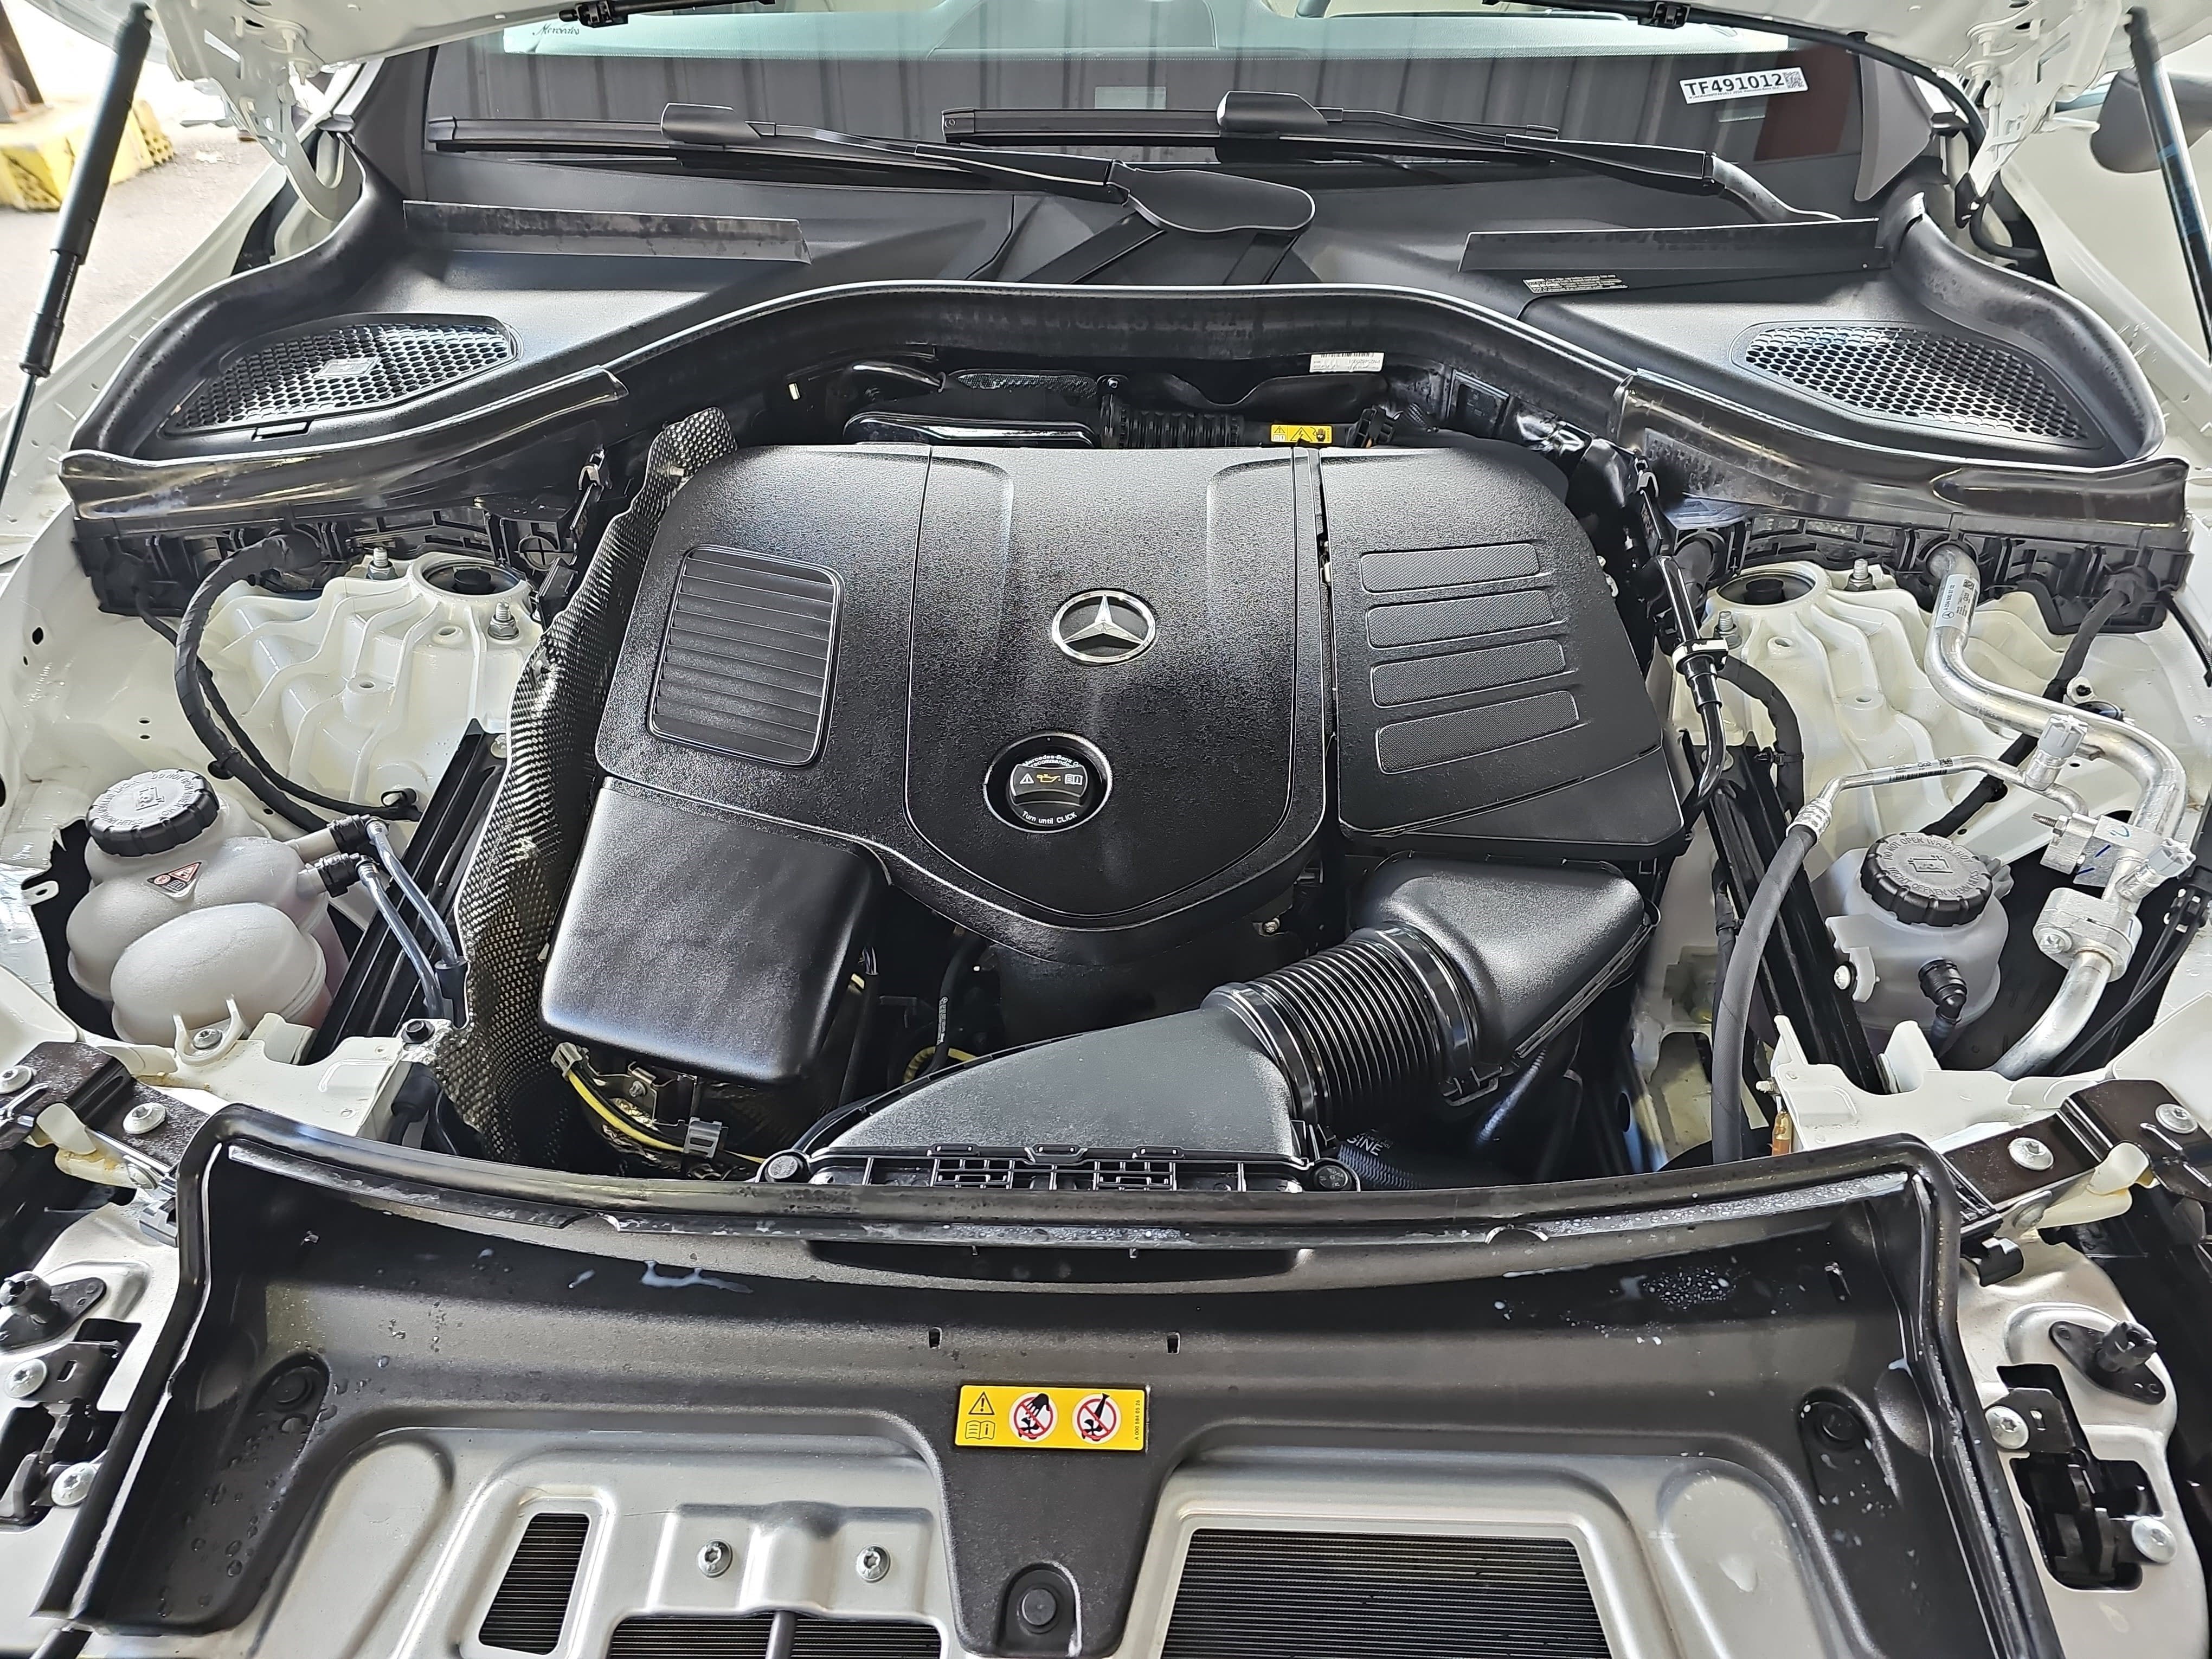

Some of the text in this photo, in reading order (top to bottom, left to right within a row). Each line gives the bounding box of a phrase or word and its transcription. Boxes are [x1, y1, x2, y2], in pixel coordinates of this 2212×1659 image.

[1684, 73, 1785, 96] TF491012
[1022, 811, 1037, 822] Turn
[1056, 812, 1077, 824] CLICK
